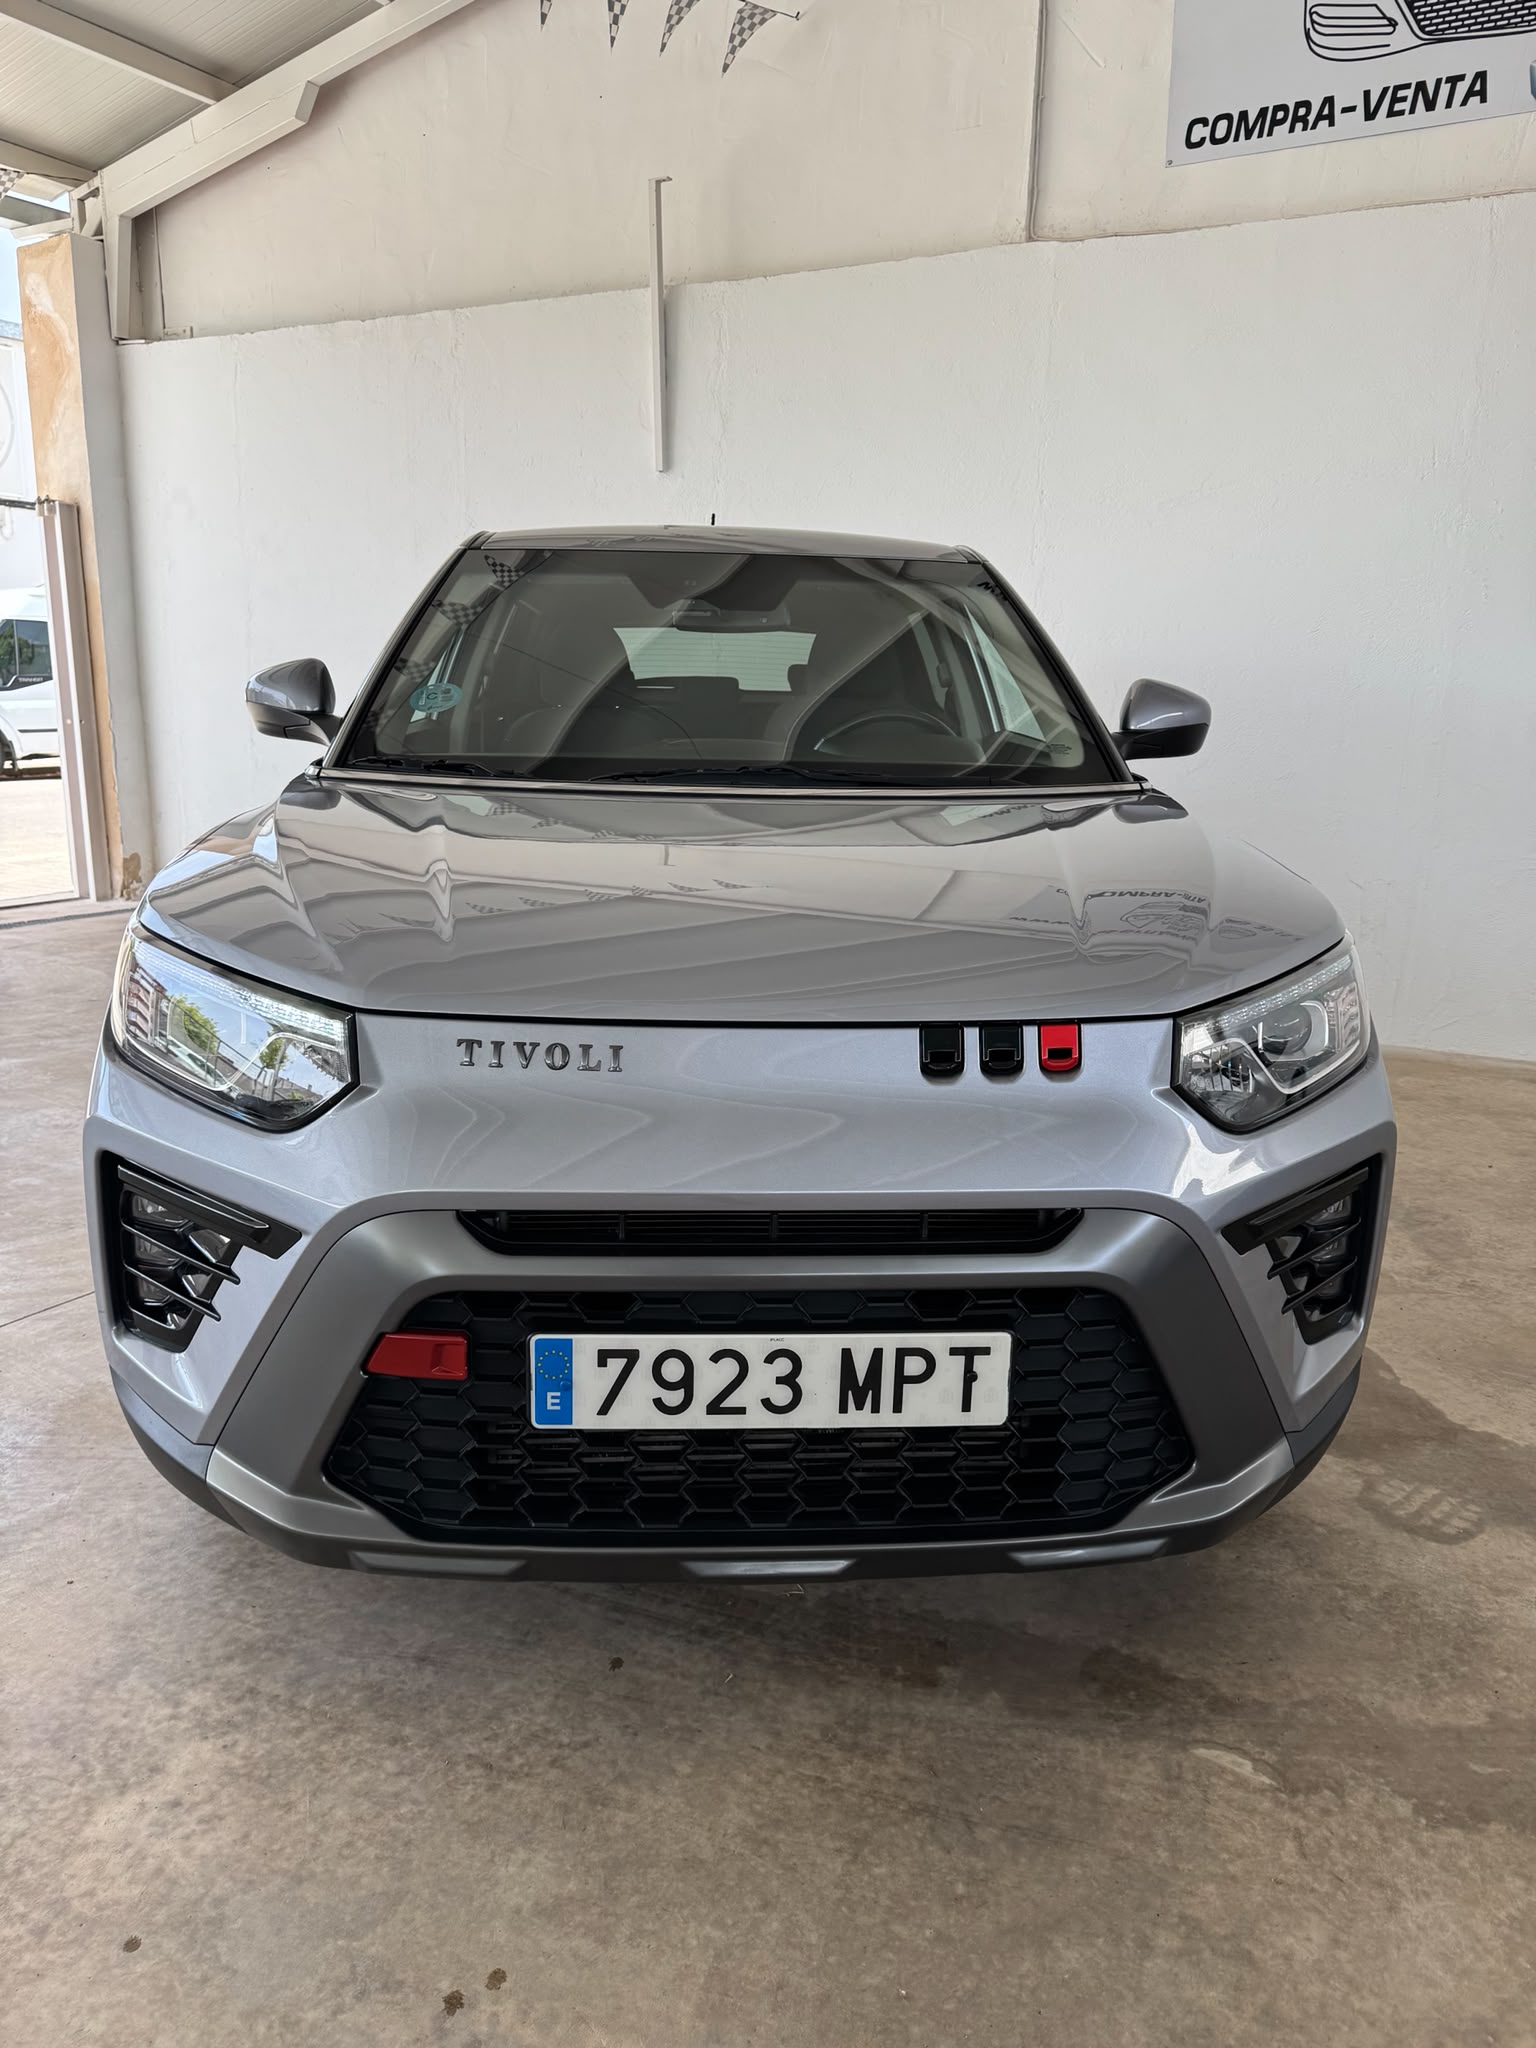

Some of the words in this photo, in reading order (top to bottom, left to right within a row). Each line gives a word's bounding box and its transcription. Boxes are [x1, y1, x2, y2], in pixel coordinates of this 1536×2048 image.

[1185, 70, 1488, 149] COMPRA-VENTA
[456, 1038, 624, 1072] TIVOLI
[546, 1392, 561, 1410] E
[596, 1348, 803, 1416] 7923
[838, 1347, 991, 1414] MPT
